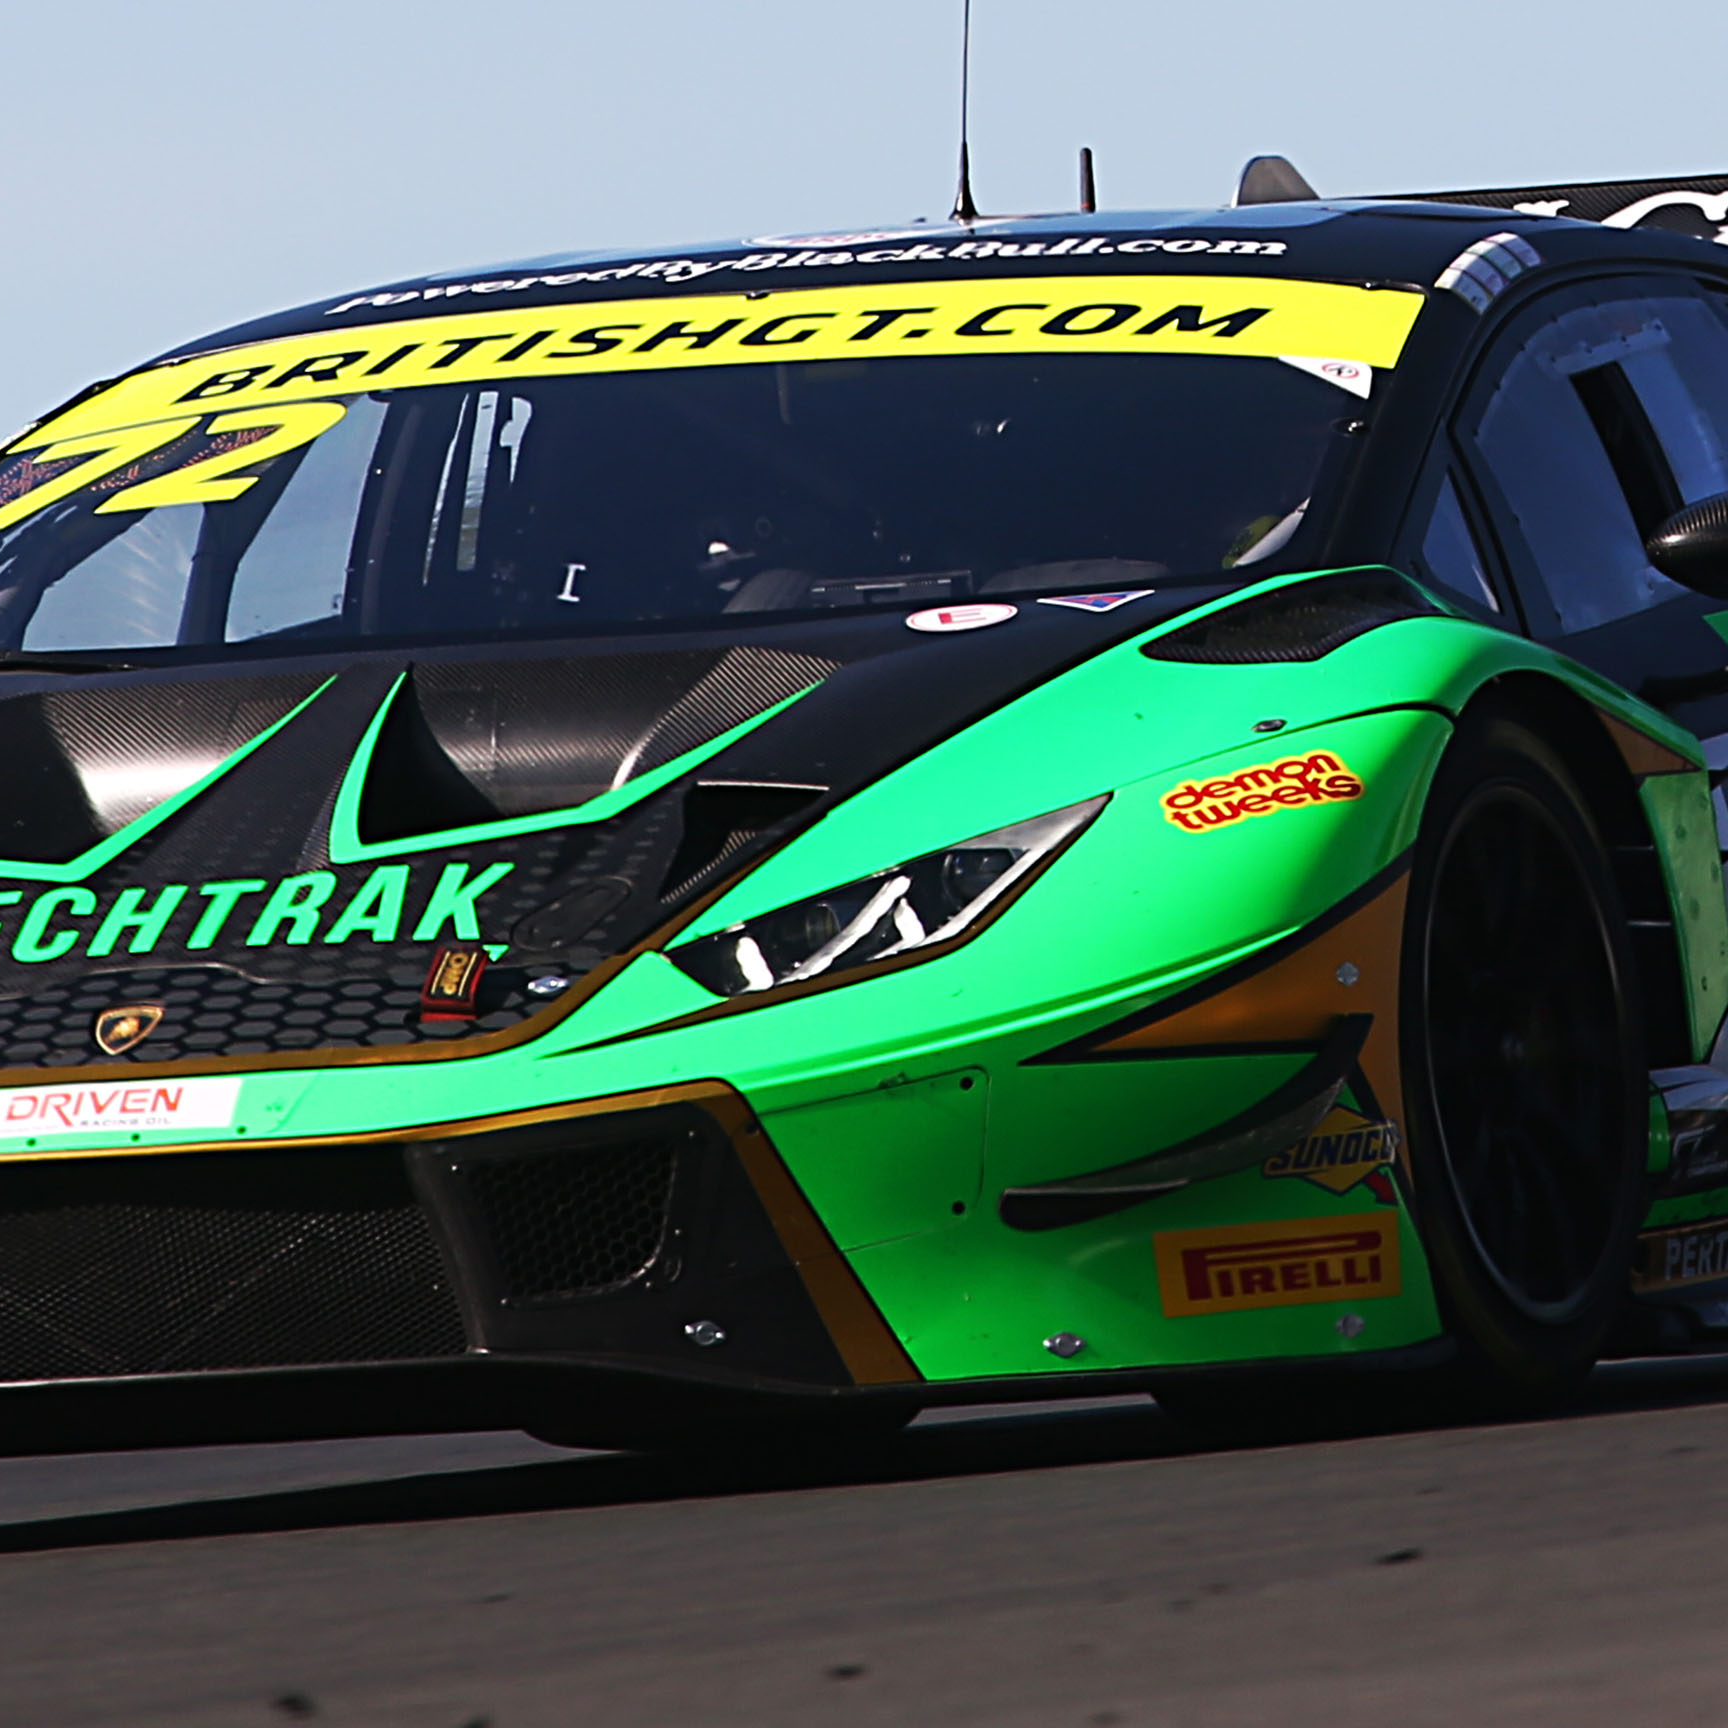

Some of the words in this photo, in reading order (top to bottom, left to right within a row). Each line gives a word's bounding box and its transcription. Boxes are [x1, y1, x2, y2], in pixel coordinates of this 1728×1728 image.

[174, 302, 1273, 404] BRITISHGT.COM
[1166, 753, 1337, 810] demon
[1169, 773, 1363, 830] tweeks
[5, 1086, 184, 1127] DRIVEN
[80, 1117, 140, 1128] RACING
[145, 1115, 173, 1126] OIL
[1182, 1230, 1382, 1302] PIRELLI
